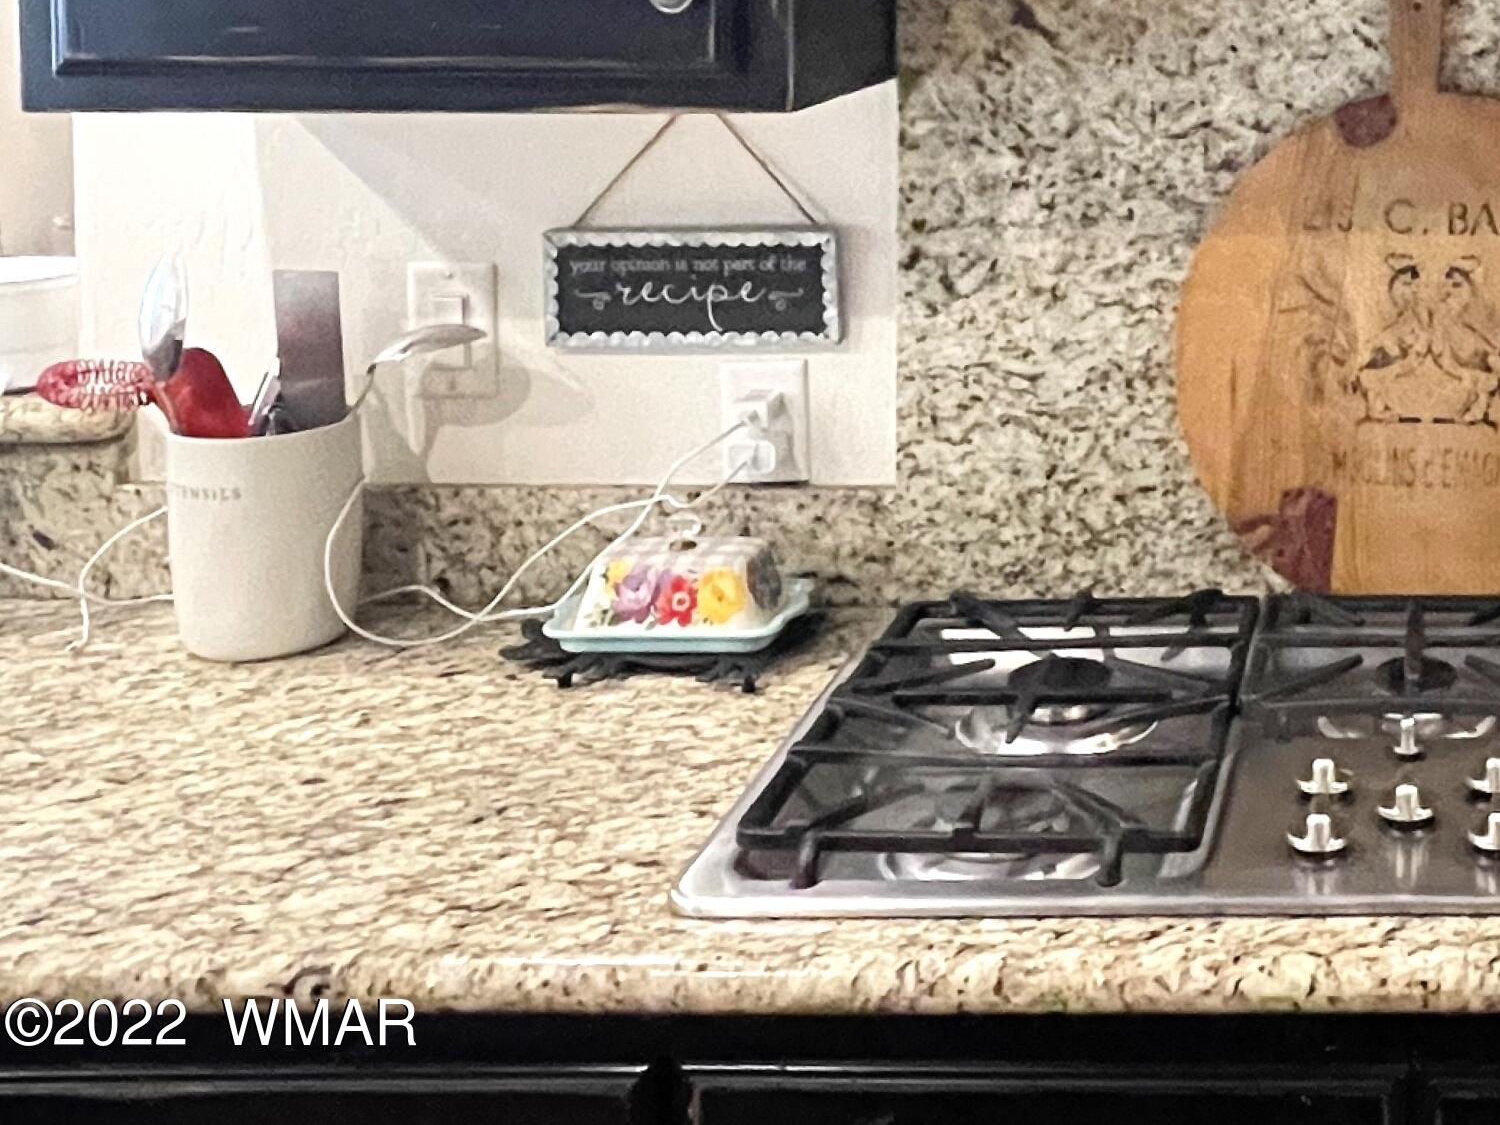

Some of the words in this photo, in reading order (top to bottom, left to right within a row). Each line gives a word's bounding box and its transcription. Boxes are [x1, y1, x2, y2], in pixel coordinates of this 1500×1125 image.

[1384, 198, 1429, 235] C.
[692, 258, 718, 272] not
[723, 258, 754, 277] part
[759, 255, 777, 272] of
[780, 255, 807, 272] the
[615, 274, 766, 332] recipe
